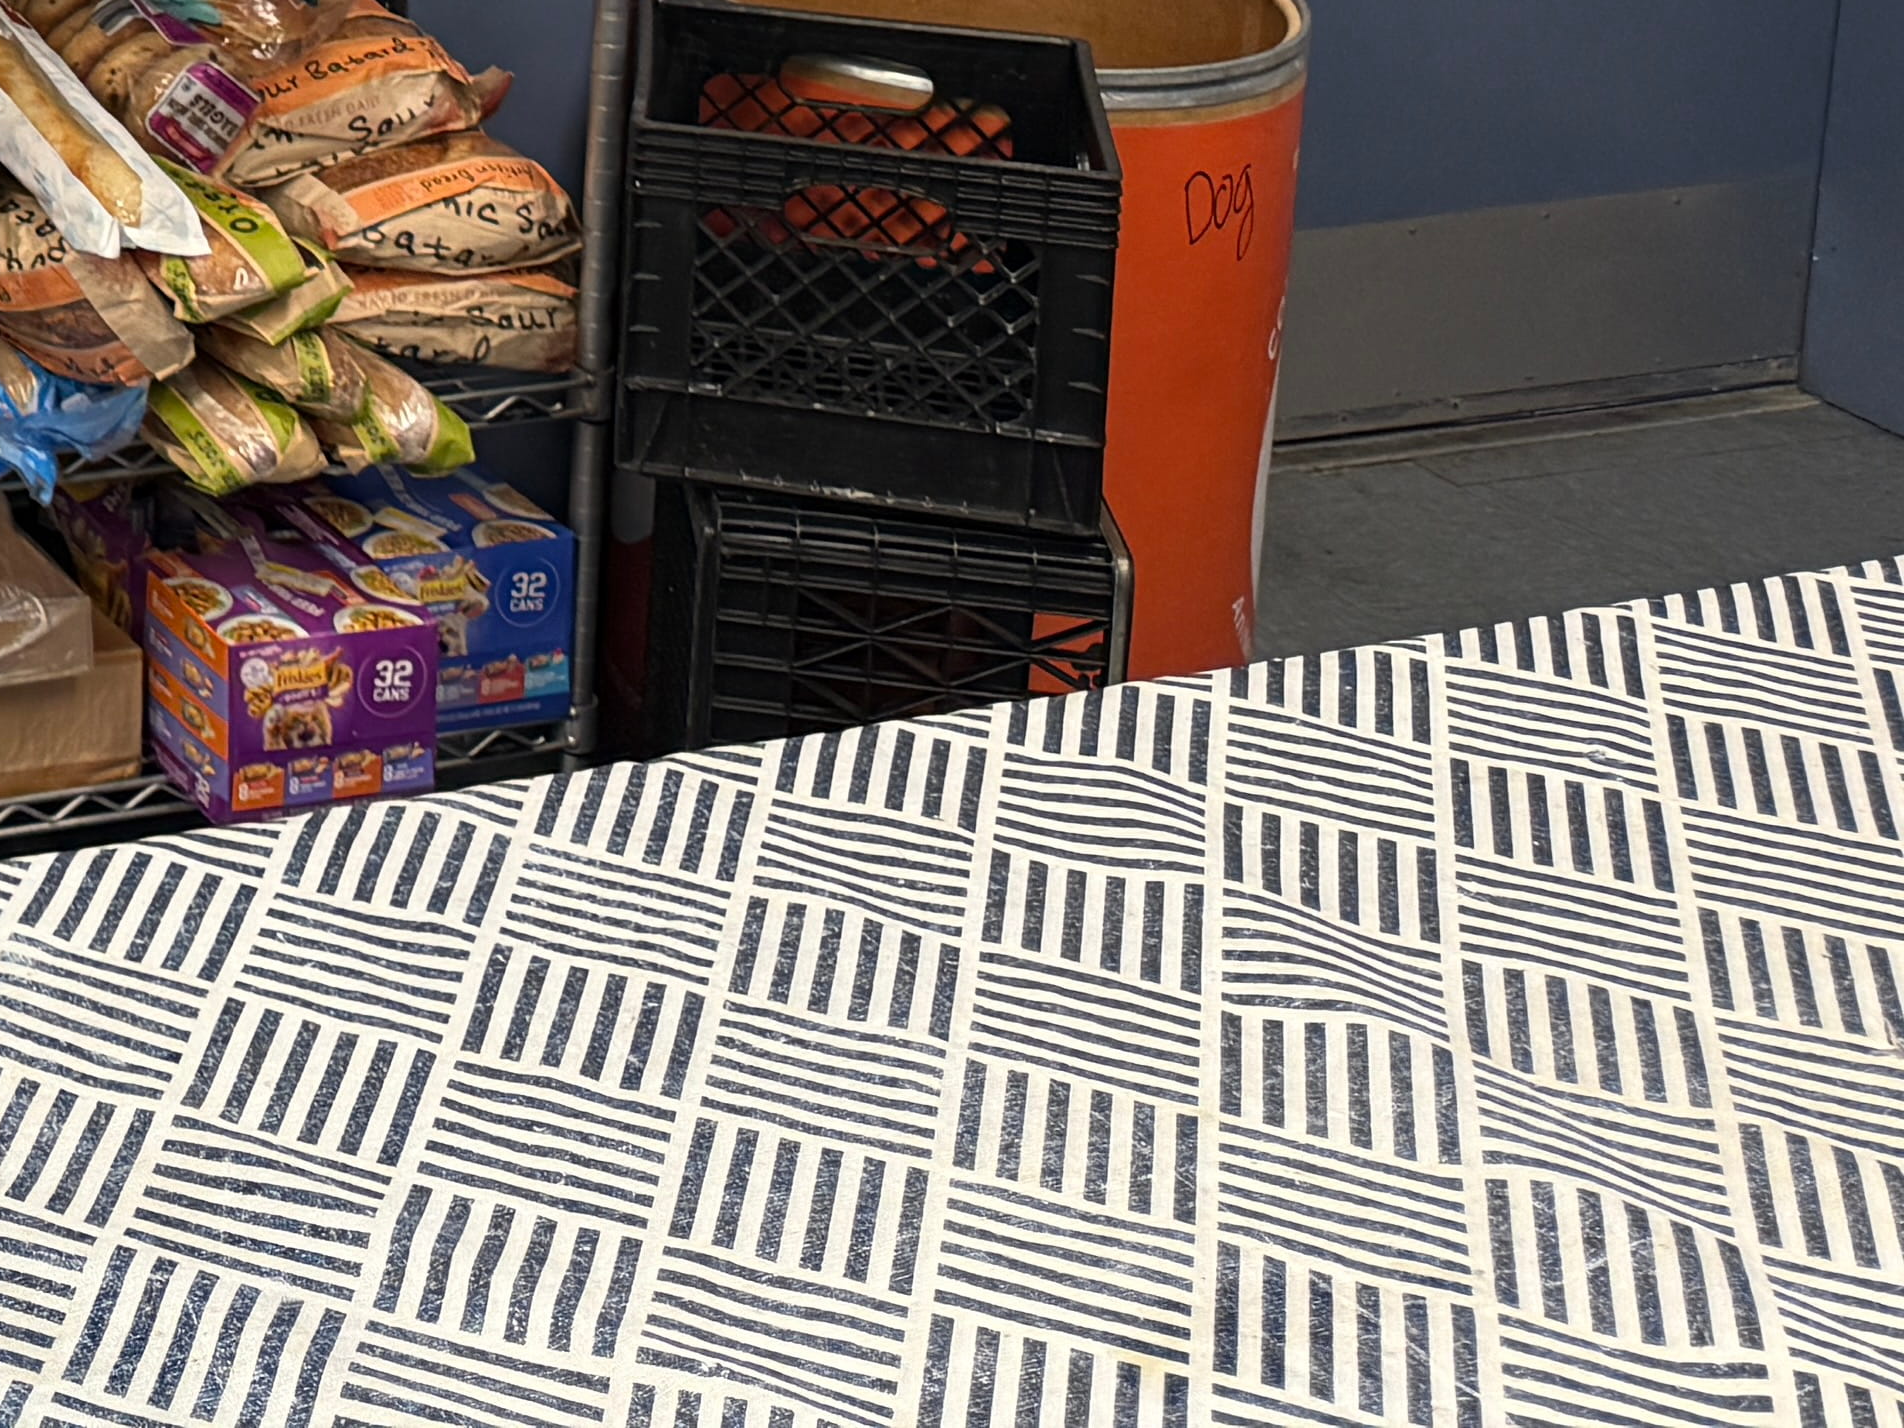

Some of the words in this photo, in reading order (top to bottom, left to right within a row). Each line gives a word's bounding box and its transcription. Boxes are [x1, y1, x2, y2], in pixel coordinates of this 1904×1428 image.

[1185, 163, 1254, 262] Dog
[511, 573, 548, 598] 32
[510, 596, 544, 612] CANS
[375, 661, 413, 690] 32
[373, 688, 409, 703] CANS
